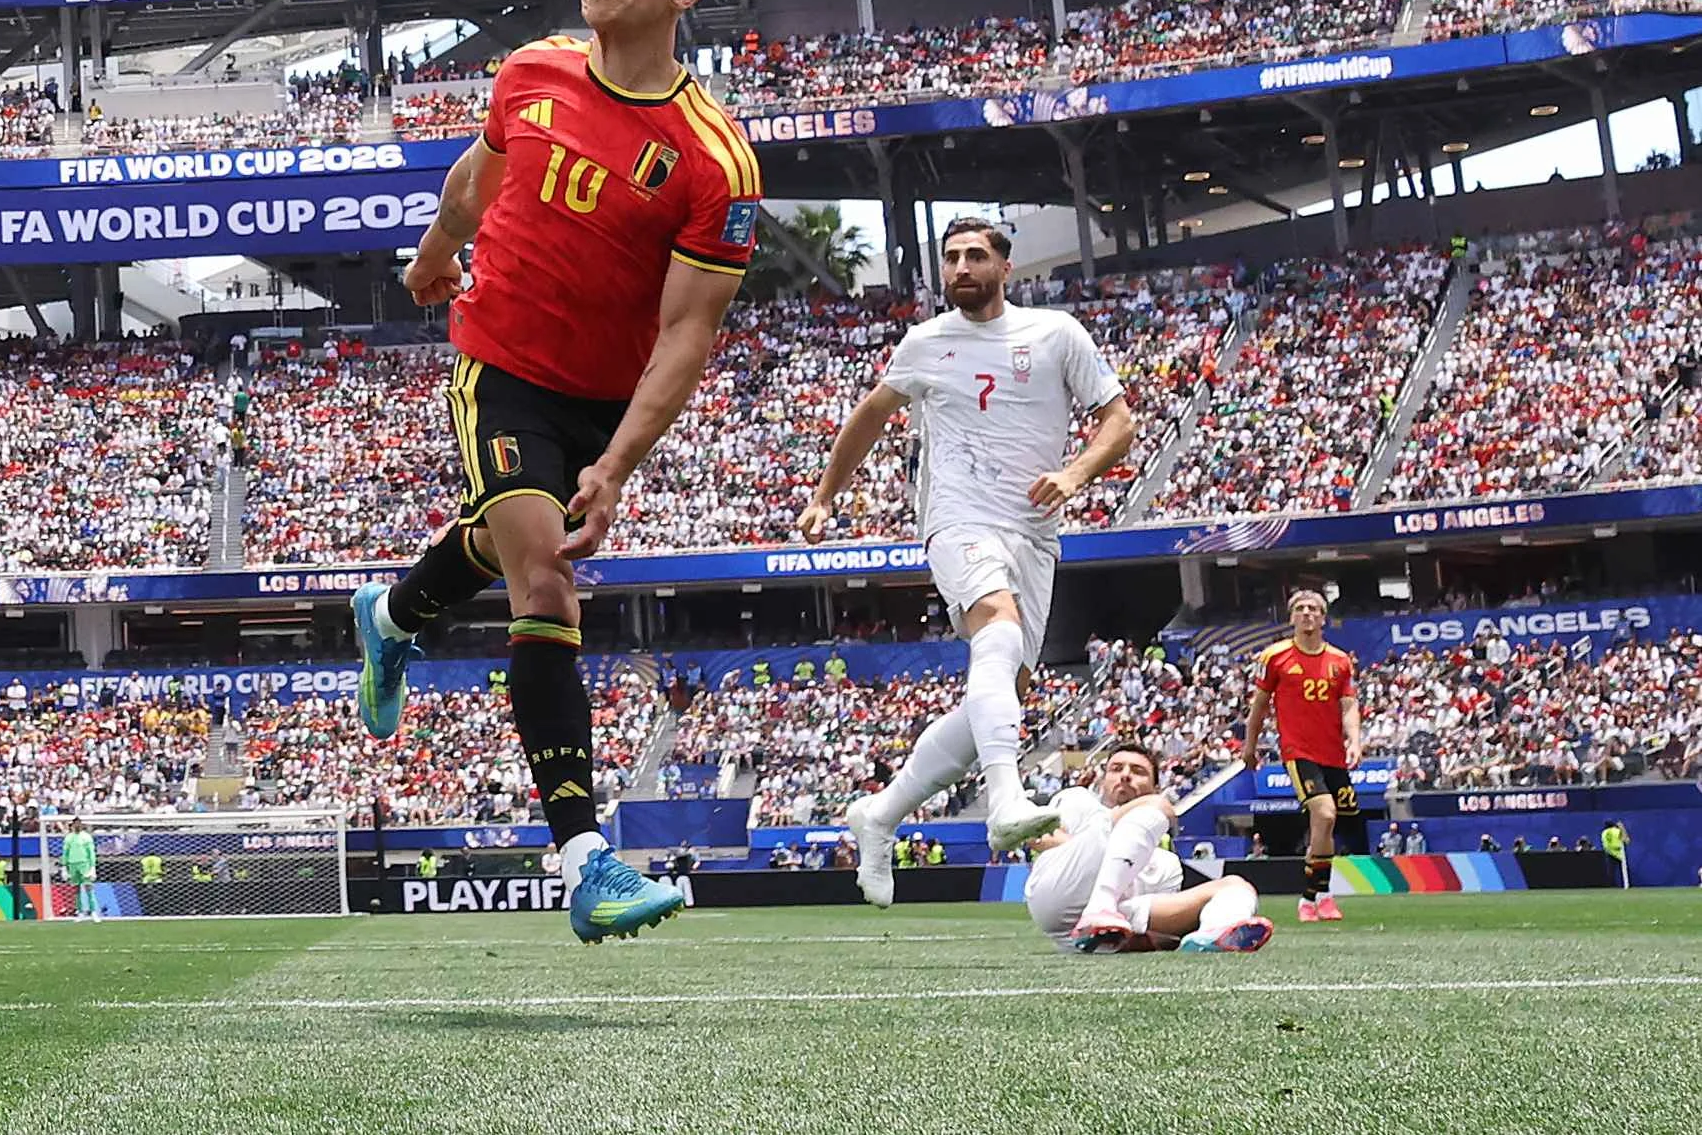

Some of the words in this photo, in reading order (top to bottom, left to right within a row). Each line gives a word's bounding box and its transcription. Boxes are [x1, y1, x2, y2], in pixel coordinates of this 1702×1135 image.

[1260, 56, 1393, 89] #FIFAWorldCup
[60, 159, 124, 184] FIFA
[125, 154, 233, 182] WORLD
[235, 150, 296, 176] CUP
[298, 146, 404, 173] 2026
[540, 143, 609, 213] 10
[57, 204, 219, 243] WORLD
[226, 199, 316, 234] CUP
[324, 192, 440, 232] 202
[975, 374, 996, 411] 7
[1394, 512, 1438, 534] LOS
[1442, 503, 1545, 530] ANGELES
[767, 553, 811, 572] FIFA
[812, 550, 886, 570] WORLD
[259, 575, 300, 592] LOS
[1390, 620, 1464, 645] LOS
[1473, 607, 1651, 639] ANGELES
[291, 671, 358, 693] 202
[1303, 678, 1329, 701] 22
[1458, 795, 1491, 812] LOS
[1492, 792, 1567, 810] ANGELES
[403, 875, 695, 912] PLAY.FIFM
